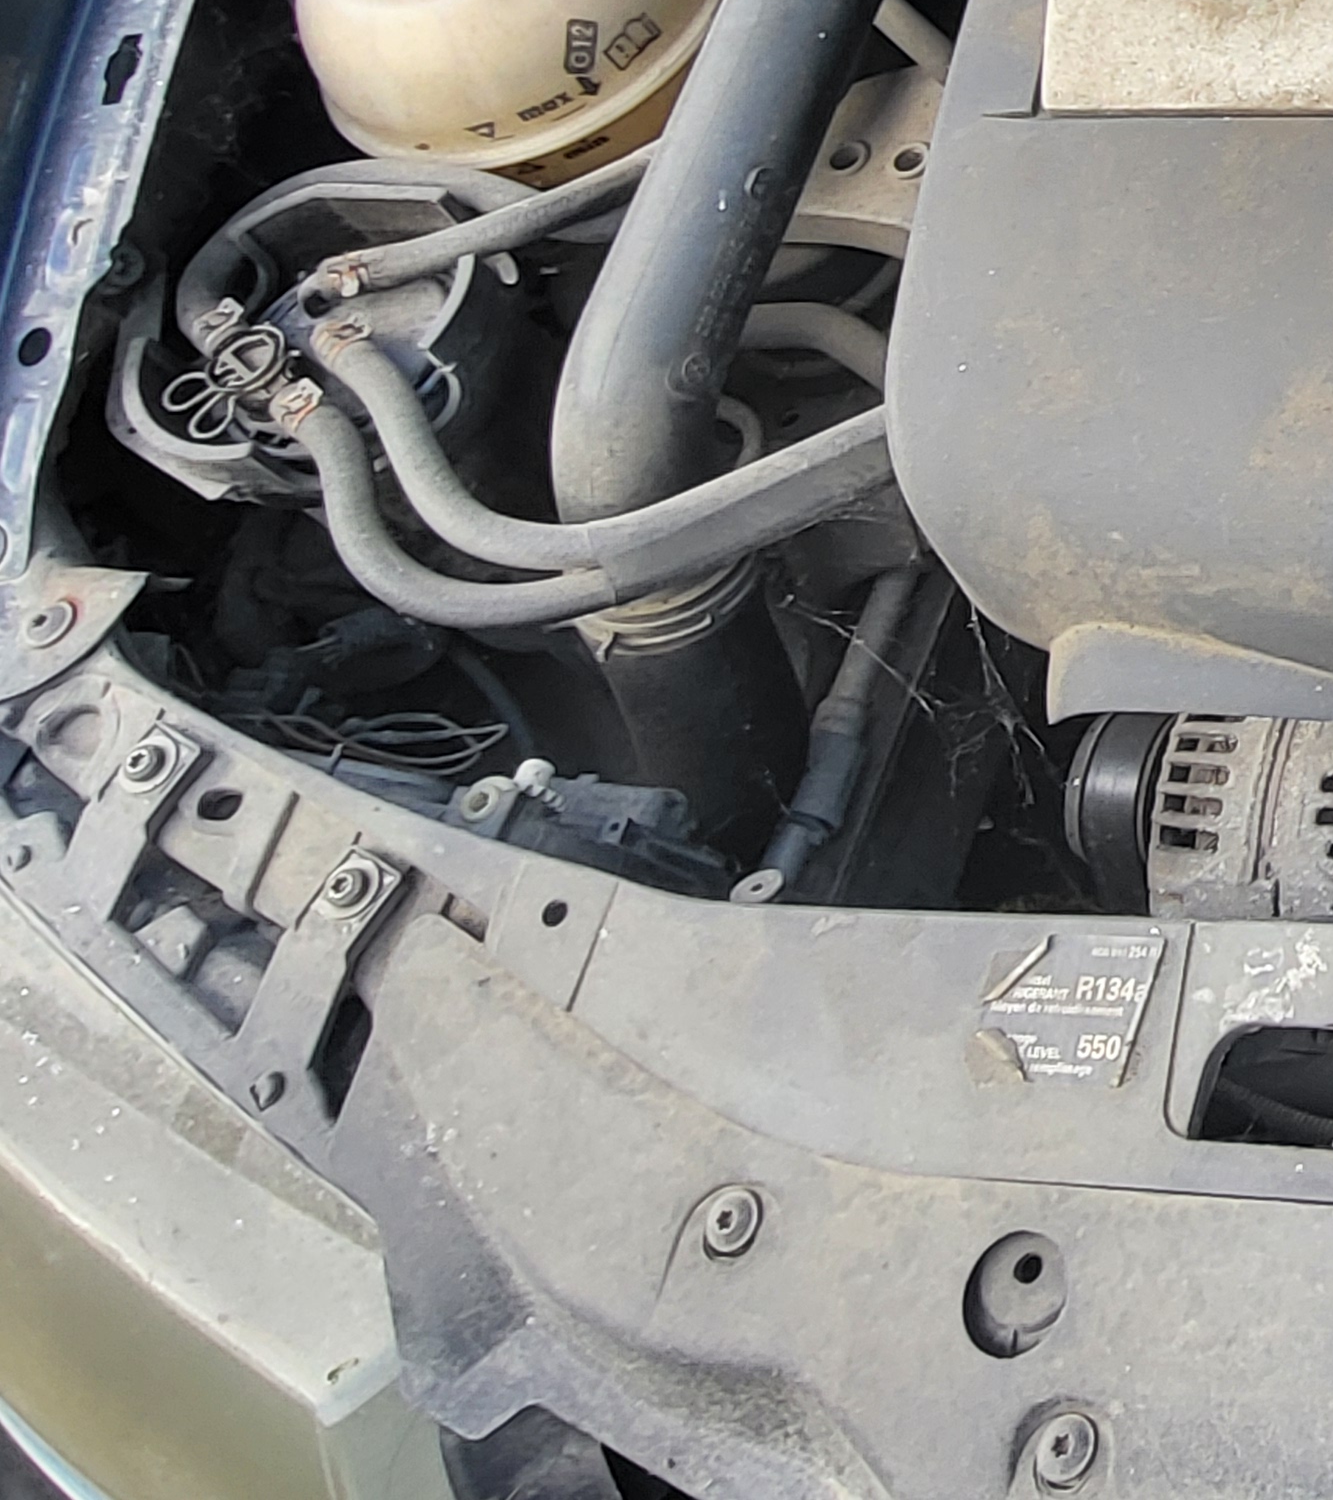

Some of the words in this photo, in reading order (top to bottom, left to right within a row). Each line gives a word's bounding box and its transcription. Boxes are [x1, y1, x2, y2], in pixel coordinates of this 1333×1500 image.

[516, 91, 575, 122] max
[1075, 975, 1148, 1003] R134a
[1076, 1034, 1122, 1061] 550
